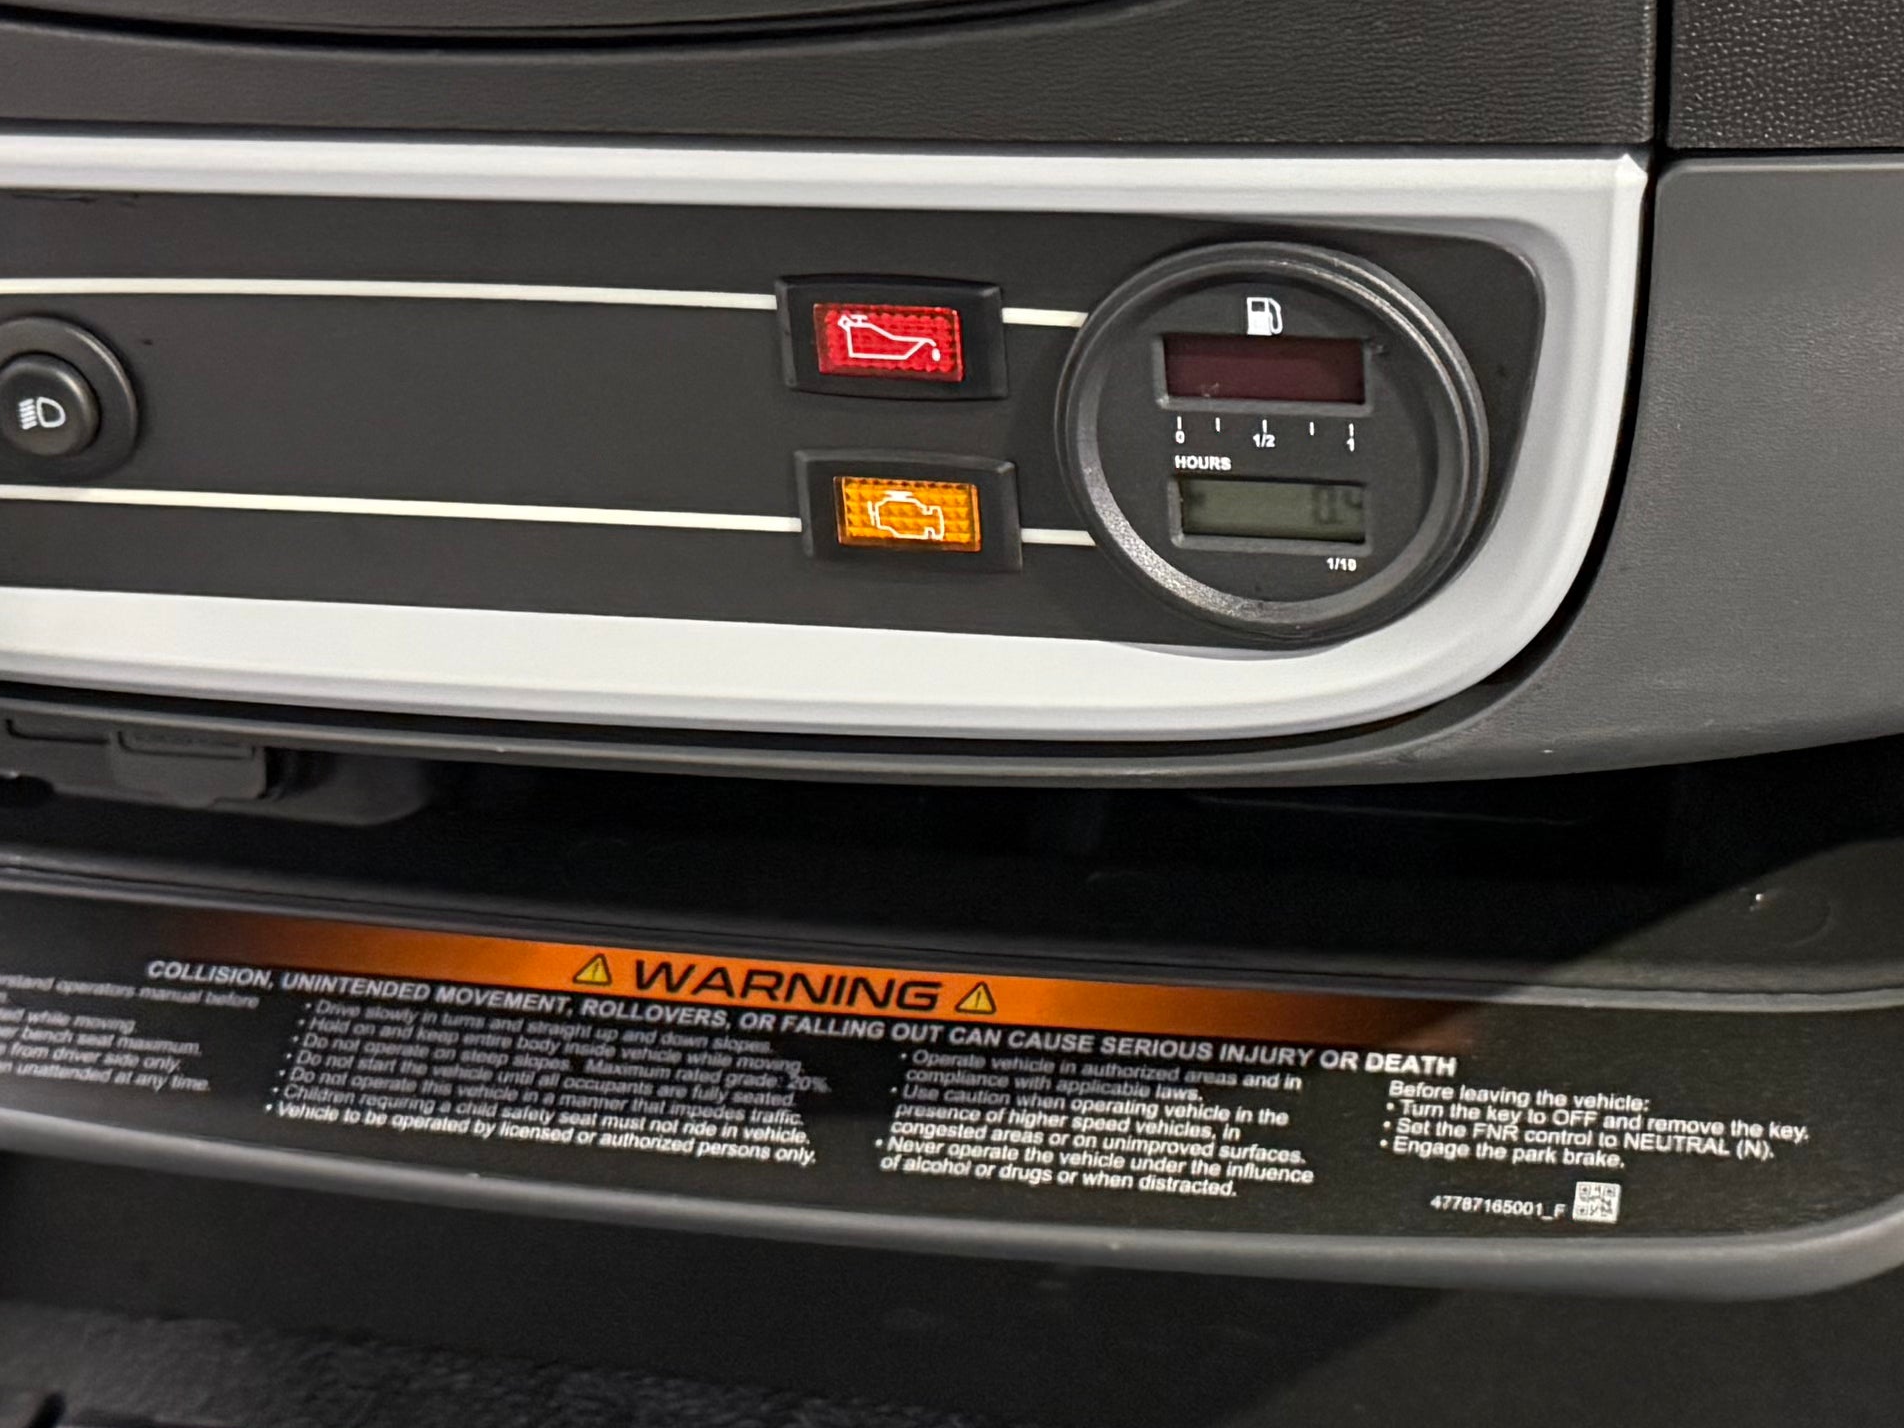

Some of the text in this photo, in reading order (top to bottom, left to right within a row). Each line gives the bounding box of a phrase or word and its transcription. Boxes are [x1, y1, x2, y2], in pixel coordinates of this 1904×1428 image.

[1174, 454, 1233, 470] HOURS
[1252, 433, 1276, 448] 1/2
[1325, 557, 1358, 571] 1/10
[634, 959, 944, 1012] WARNING
[147, 960, 1456, 1076] COLLISION, UNINTENDED MOVEMENT, ROLLOVERS, OR FALLING OUT CAN CAUSE SERIOUS INJURY OR DEATH
[295, 1048, 794, 1107] Do not start the vehicle until all occupants are fully seated.
[905, 1069, 1203, 1101] compliance with applicable laws.
[912, 1049, 1302, 1090] Operate vehicle in authorized areas and in
[283, 1083, 809, 1144] Children requiring a child safety seat must not ride in vehicle.
[288, 1065, 803, 1126] Do not operate this vehicle in a manner that impedes traffic.
[902, 1083, 1289, 1126] Use caution when operating vehicle in the
[1388, 1079, 1649, 1112] Before leaving the vehicle:
[278, 1101, 815, 1166] Vehicle to be operated by licensed or authorized persons only.
[890, 1121, 1305, 1164] congested areas or on unimproved surfaces.
[894, 1104, 1241, 1140] presence of higher speed vehicles, in
[1396, 1117, 1774, 1160] Set the FNR control to NEUTRAL (N).
[1400, 1098, 1808, 1144] Turn the key to OFF and remove the key.
[887, 1136, 1313, 1183] Never operate the vehicle under the influence
[1393, 1135, 1624, 1168] Engage the park brake.
[879, 1154, 1236, 1196] of alcohol or drugs or when distracted.
[1430, 1195, 1565, 1220] 47787165001_F
